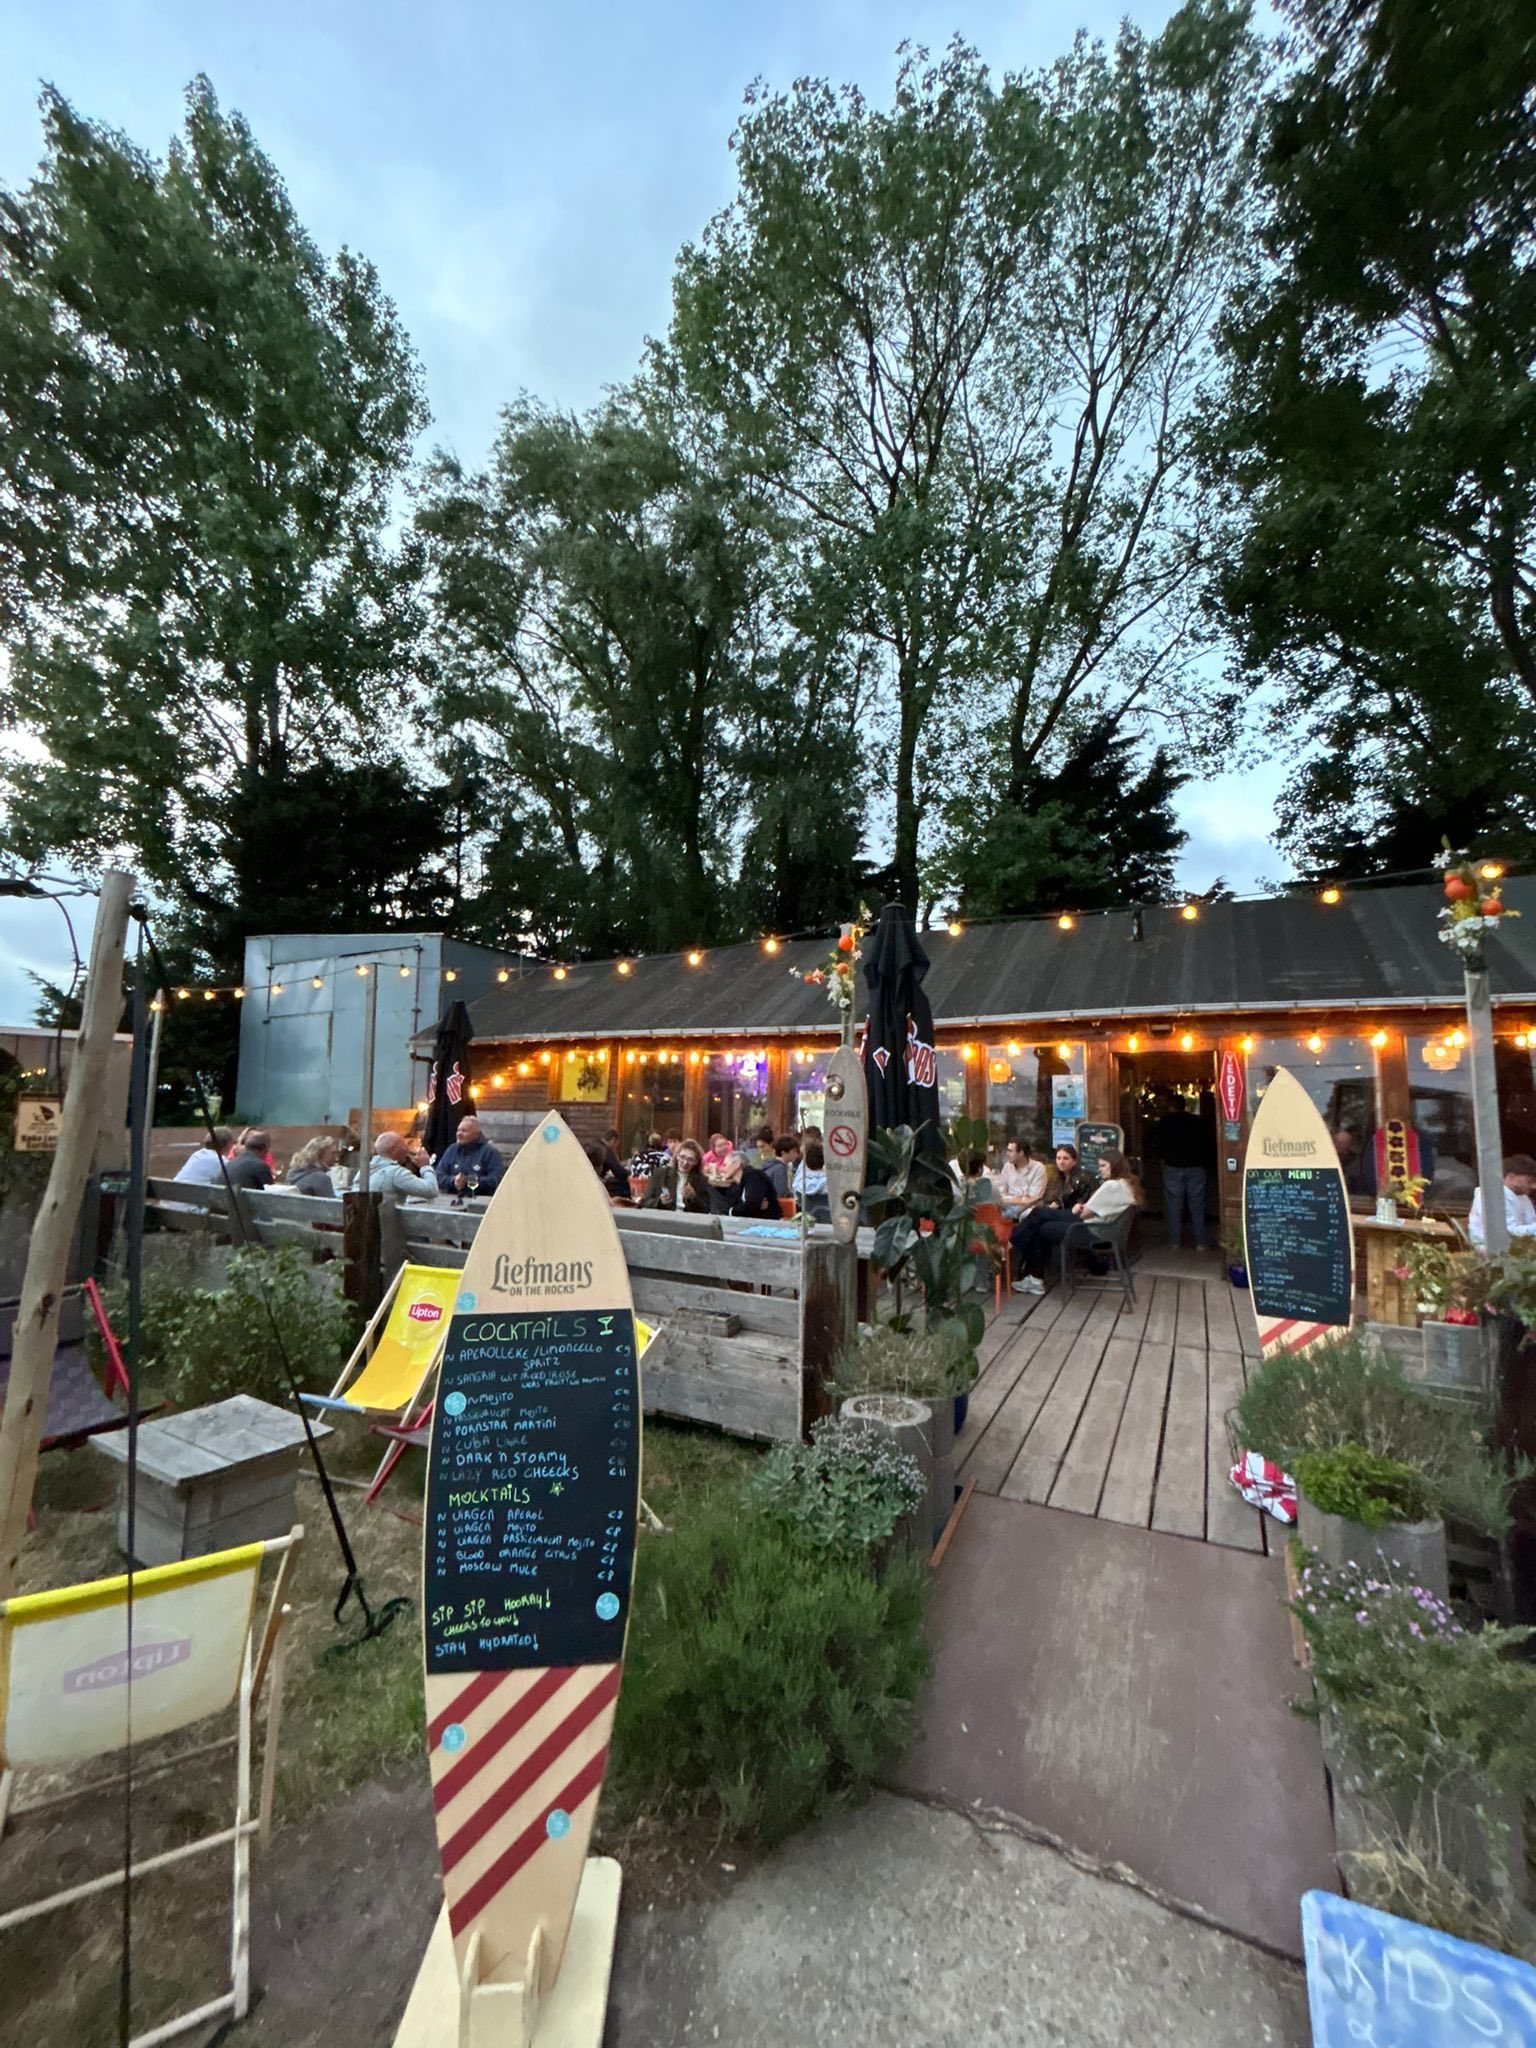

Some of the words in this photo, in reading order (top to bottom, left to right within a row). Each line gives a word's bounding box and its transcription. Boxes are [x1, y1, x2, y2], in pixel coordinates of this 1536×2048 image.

[1263, 1138, 1317, 1156] Liefmans
[490, 1254, 593, 1293] Liefmans
[510, 1287, 522, 1296] ON
[525, 1286, 542, 1295] THE
[545, 1285, 575, 1295] ROCKS
[411, 1306, 440, 1319] Lipton
[463, 1317, 587, 1342] COCKTAILS
[457, 1370, 497, 1386] SANGRIA
[455, 1421, 508, 1437] PORNSTAR
[513, 1416, 557, 1432] MARTINI
[456, 1452, 493, 1467] DARK
[491, 1468, 518, 1481] RED
[448, 1483, 531, 1508] MOCKTAILS
[507, 1509, 545, 1521] APEROL
[456, 1549, 485, 1561] BLOOD
[499, 1547, 537, 1560] ORANGE
[459, 1562, 502, 1575] MOSCOW
[509, 1563, 538, 1576] MULE
[435, 1641, 467, 1658] STAY
[1340, 1932, 1503, 2037] KIDS
